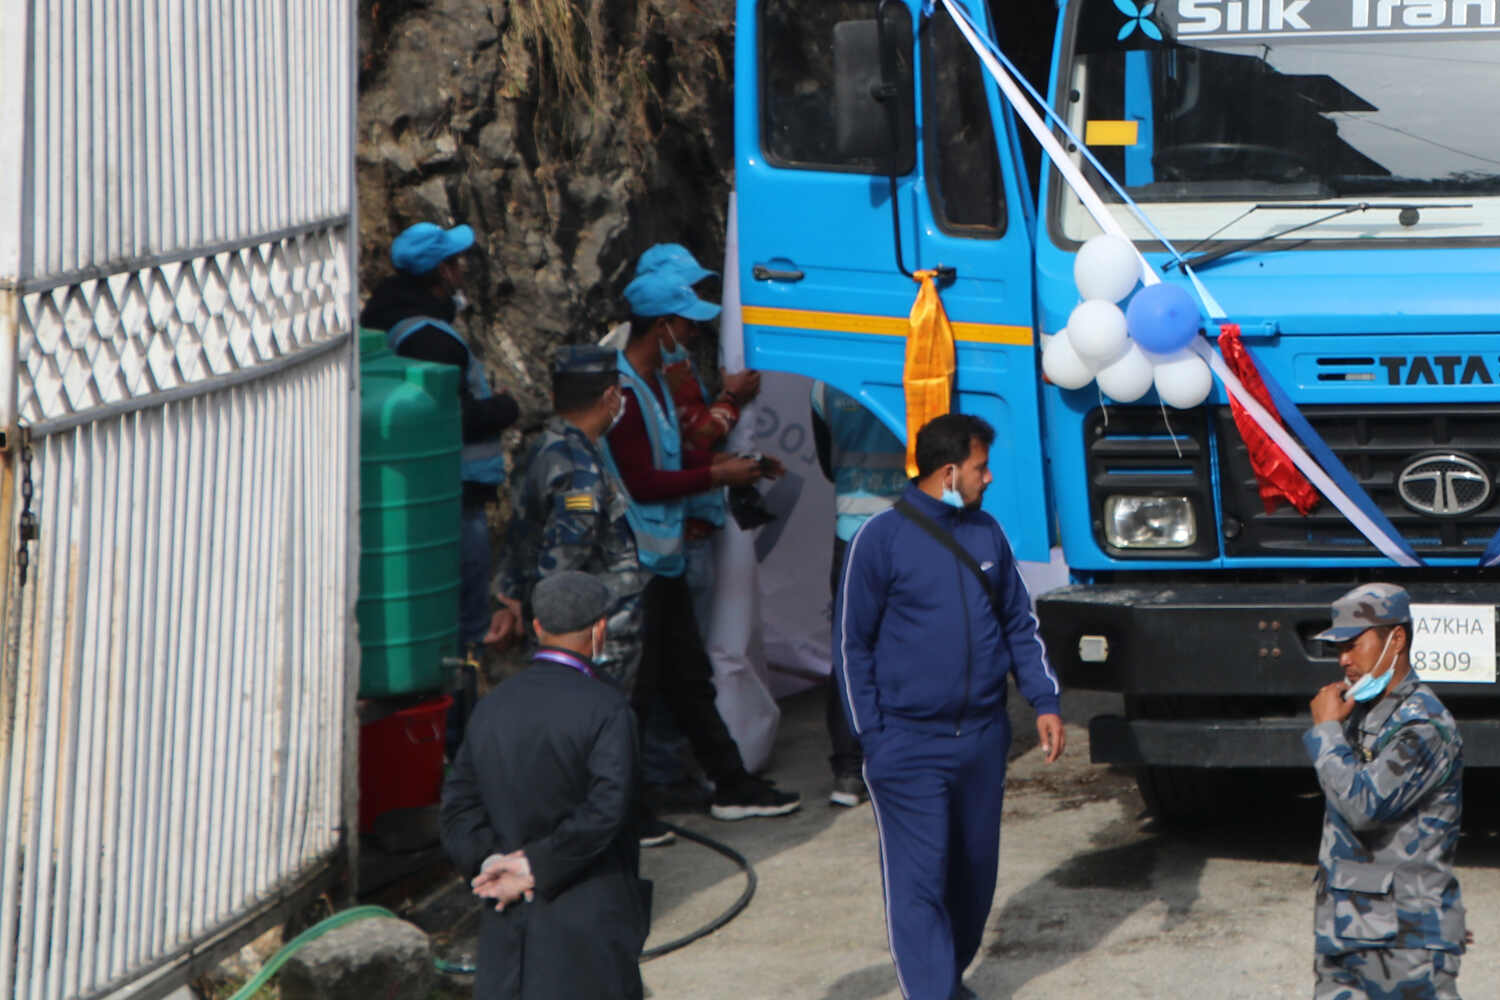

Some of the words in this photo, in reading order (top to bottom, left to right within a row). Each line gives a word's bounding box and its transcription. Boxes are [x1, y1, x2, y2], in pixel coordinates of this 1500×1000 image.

[1379, 355, 1494, 385] TATA
[1415, 616, 1485, 635] A7KHA
[1413, 650, 1471, 672] 8309
